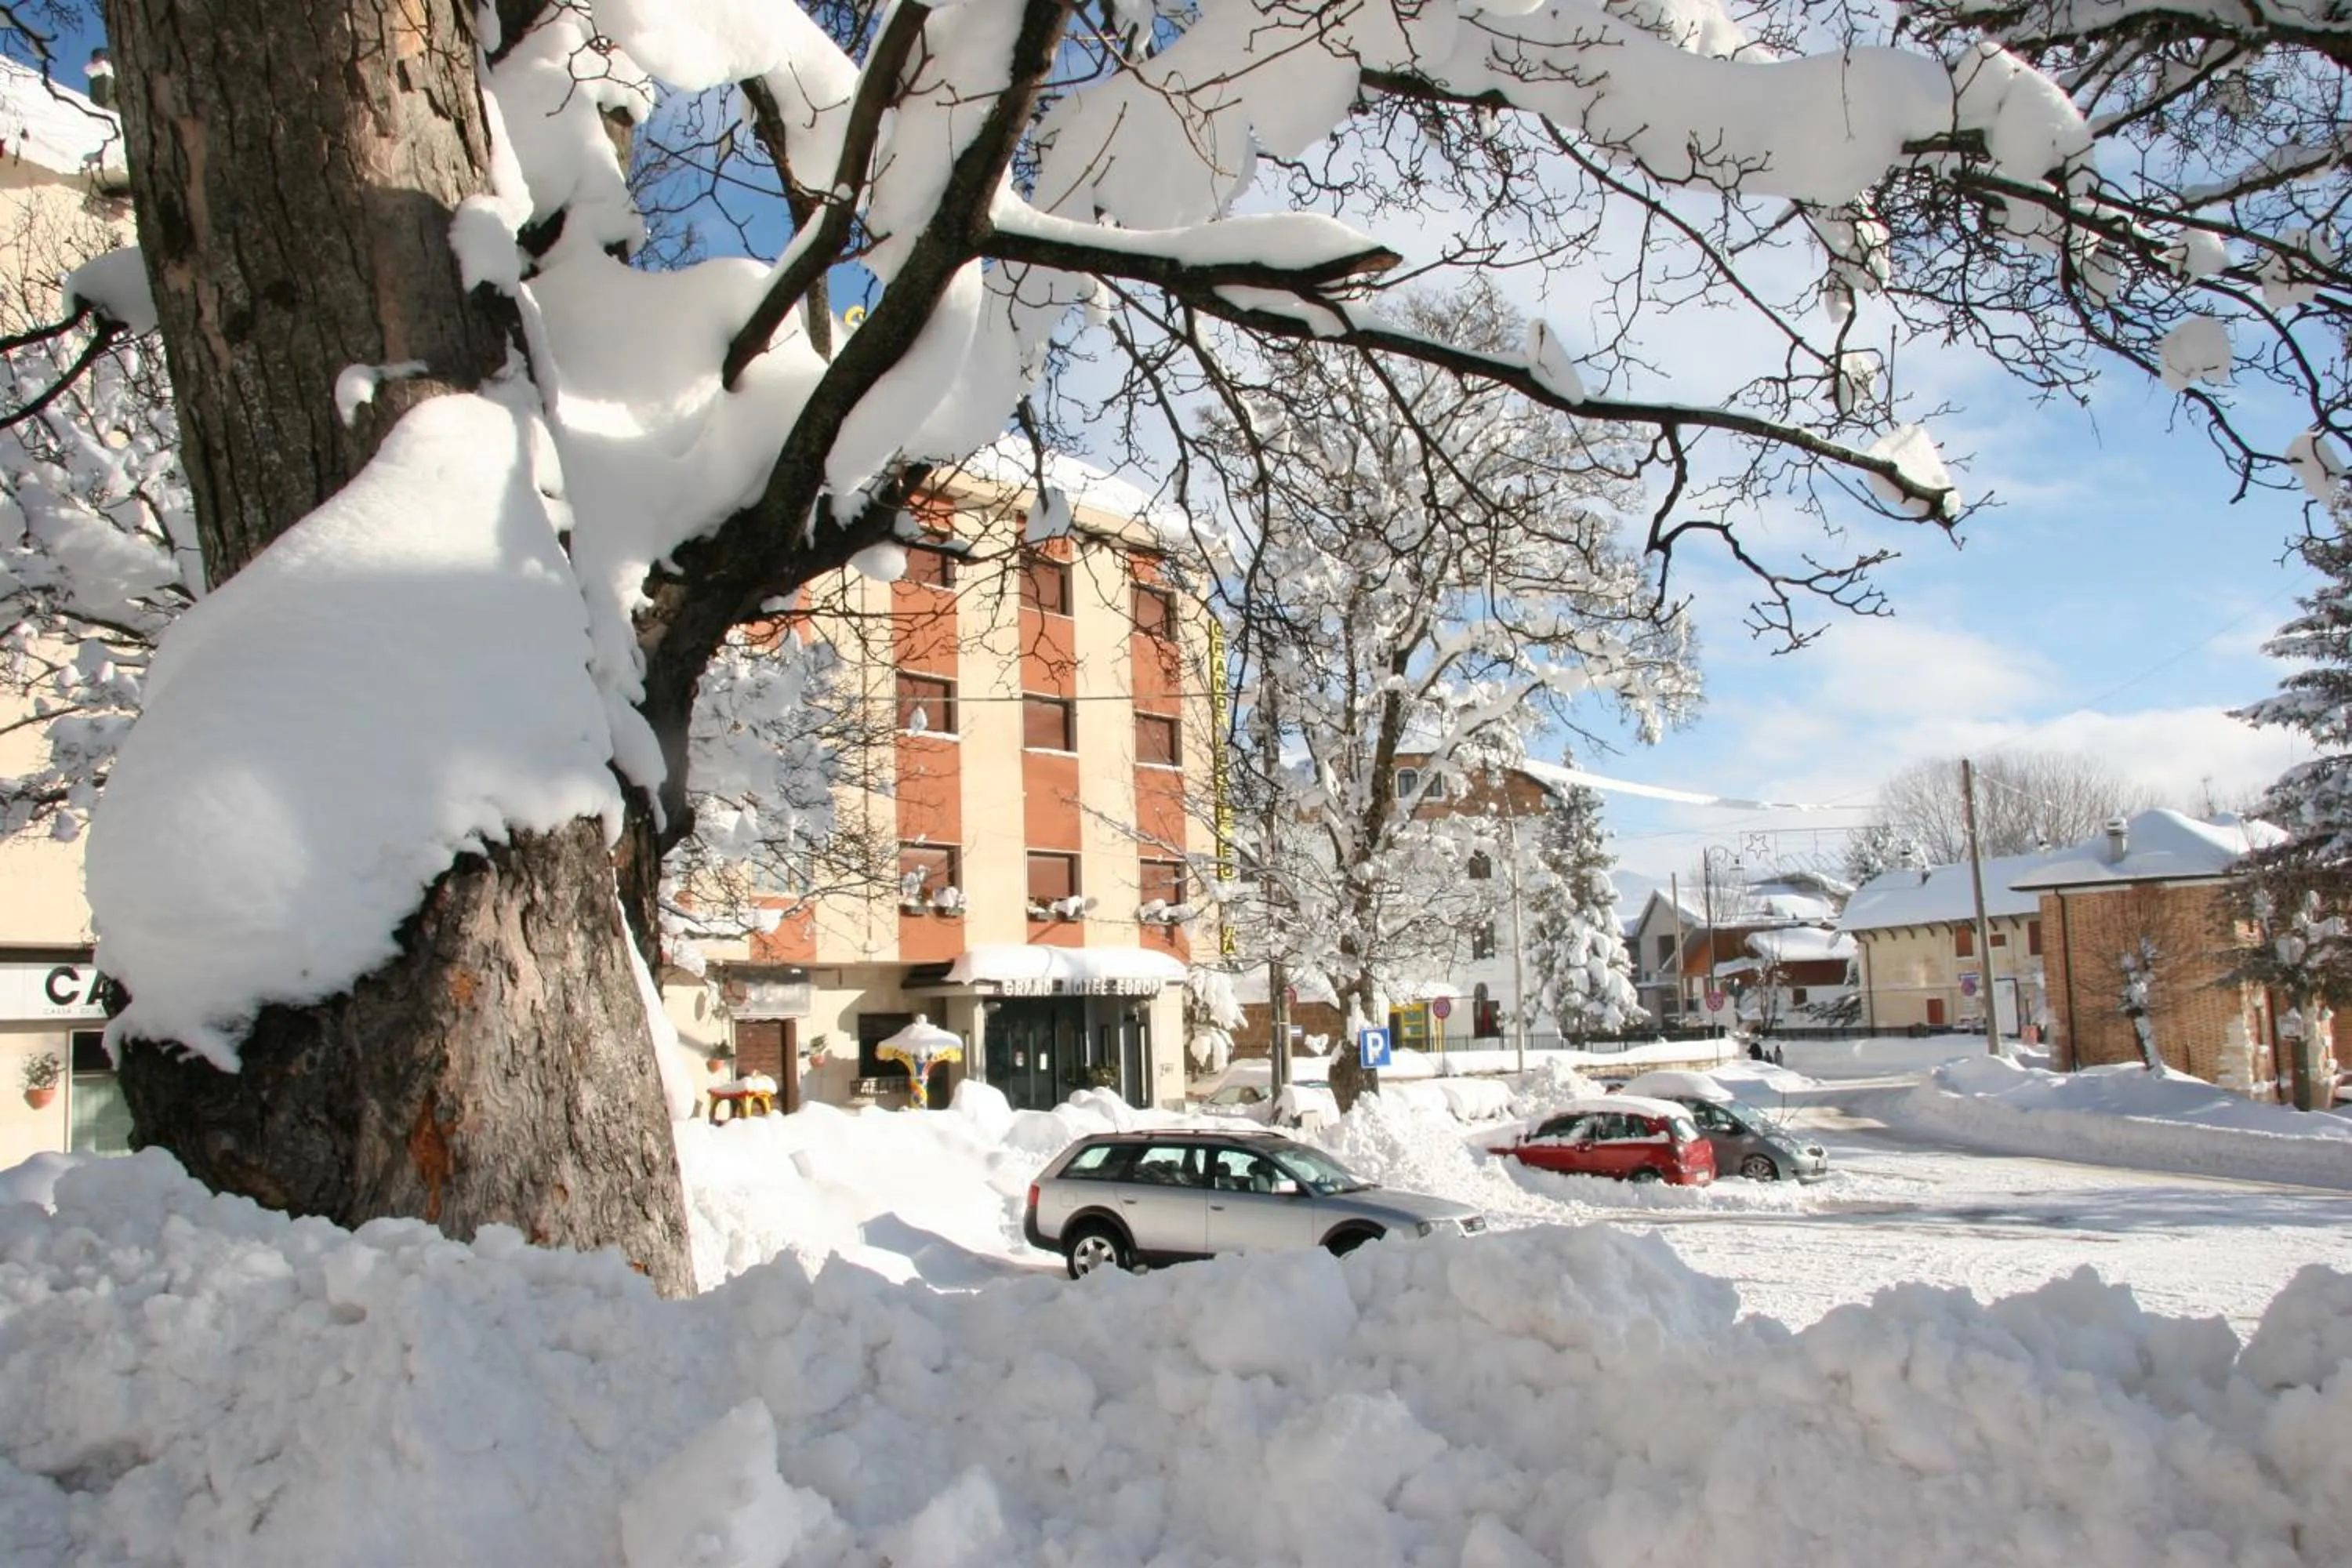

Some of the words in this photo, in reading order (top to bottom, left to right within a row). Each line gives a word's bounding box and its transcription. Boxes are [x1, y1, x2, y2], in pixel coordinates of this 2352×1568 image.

[1213, 620, 1227, 710] GRAND
[1004, 978, 1053, 996] GRAND
[1062, 978, 1108, 996] HOTEL
[1116, 978, 1163, 996] EUROP
[1367, 1033, 1384, 1064] P
